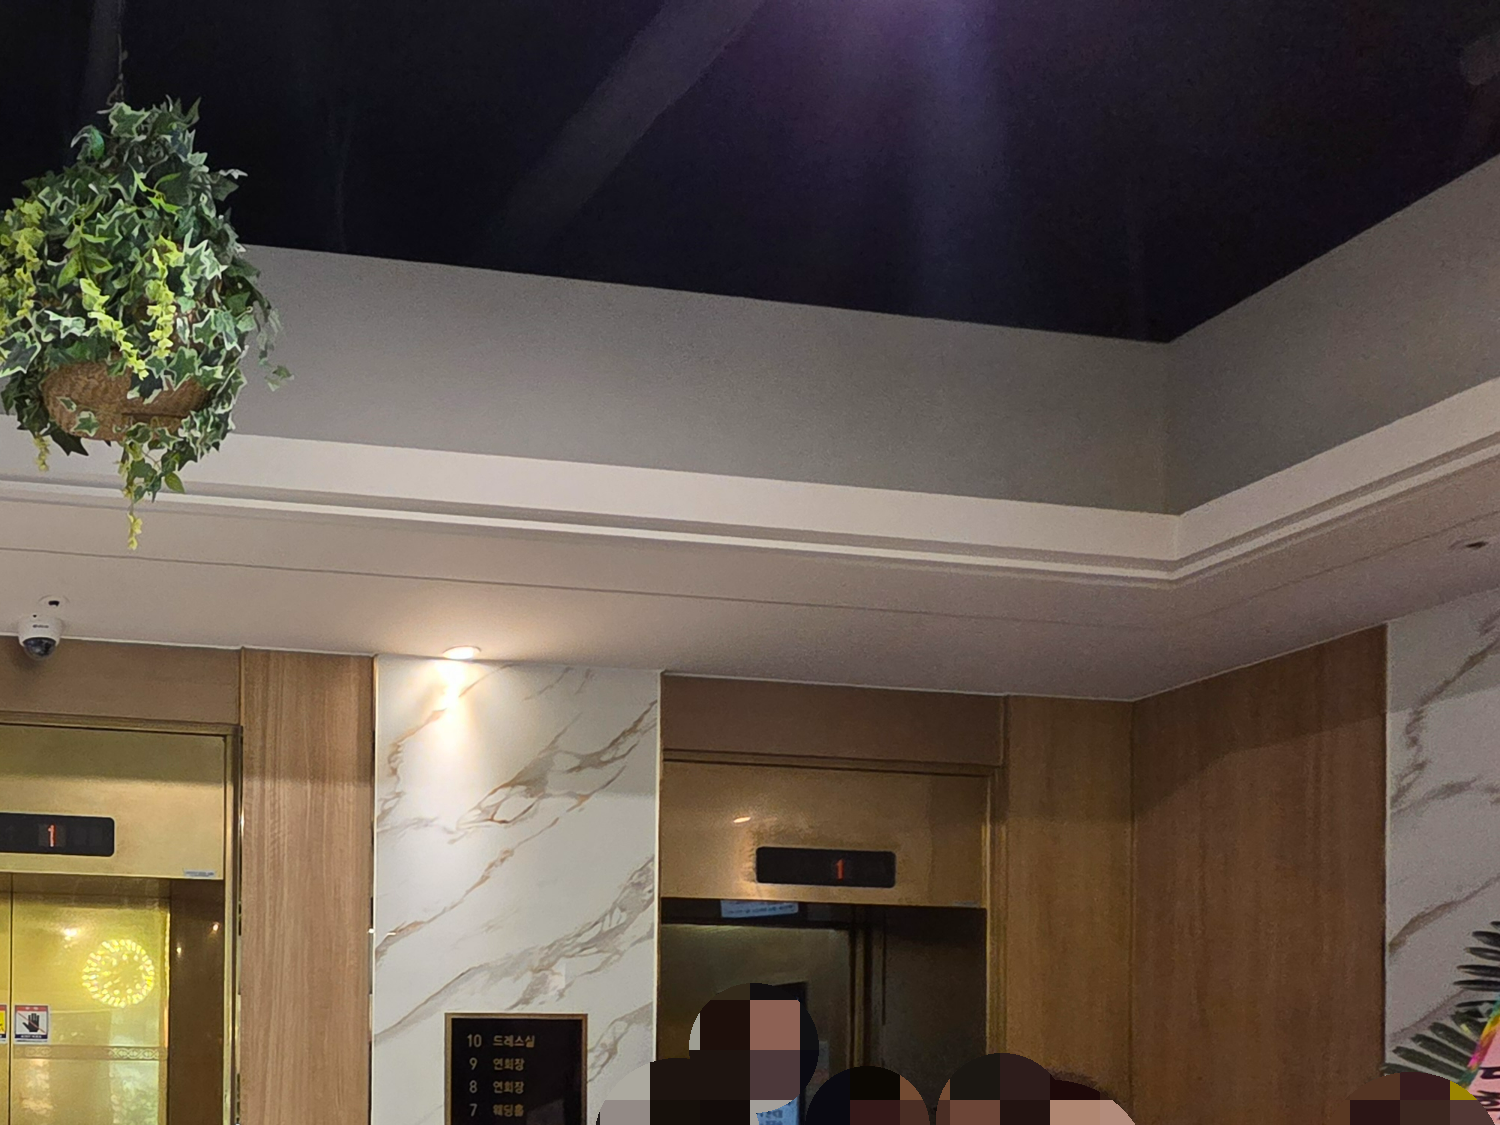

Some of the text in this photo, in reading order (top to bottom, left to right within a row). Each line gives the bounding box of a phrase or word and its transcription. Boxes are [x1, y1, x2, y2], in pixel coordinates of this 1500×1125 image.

[47, 824, 57, 848] 1
[834, 859, 845, 880] 1
[467, 1035, 535, 1048] 10 드레스실
[469, 1058, 524, 1071] 9 연회장
[469, 1081, 524, 1094] 8 연회장
[469, 1104, 477, 1117] 7
